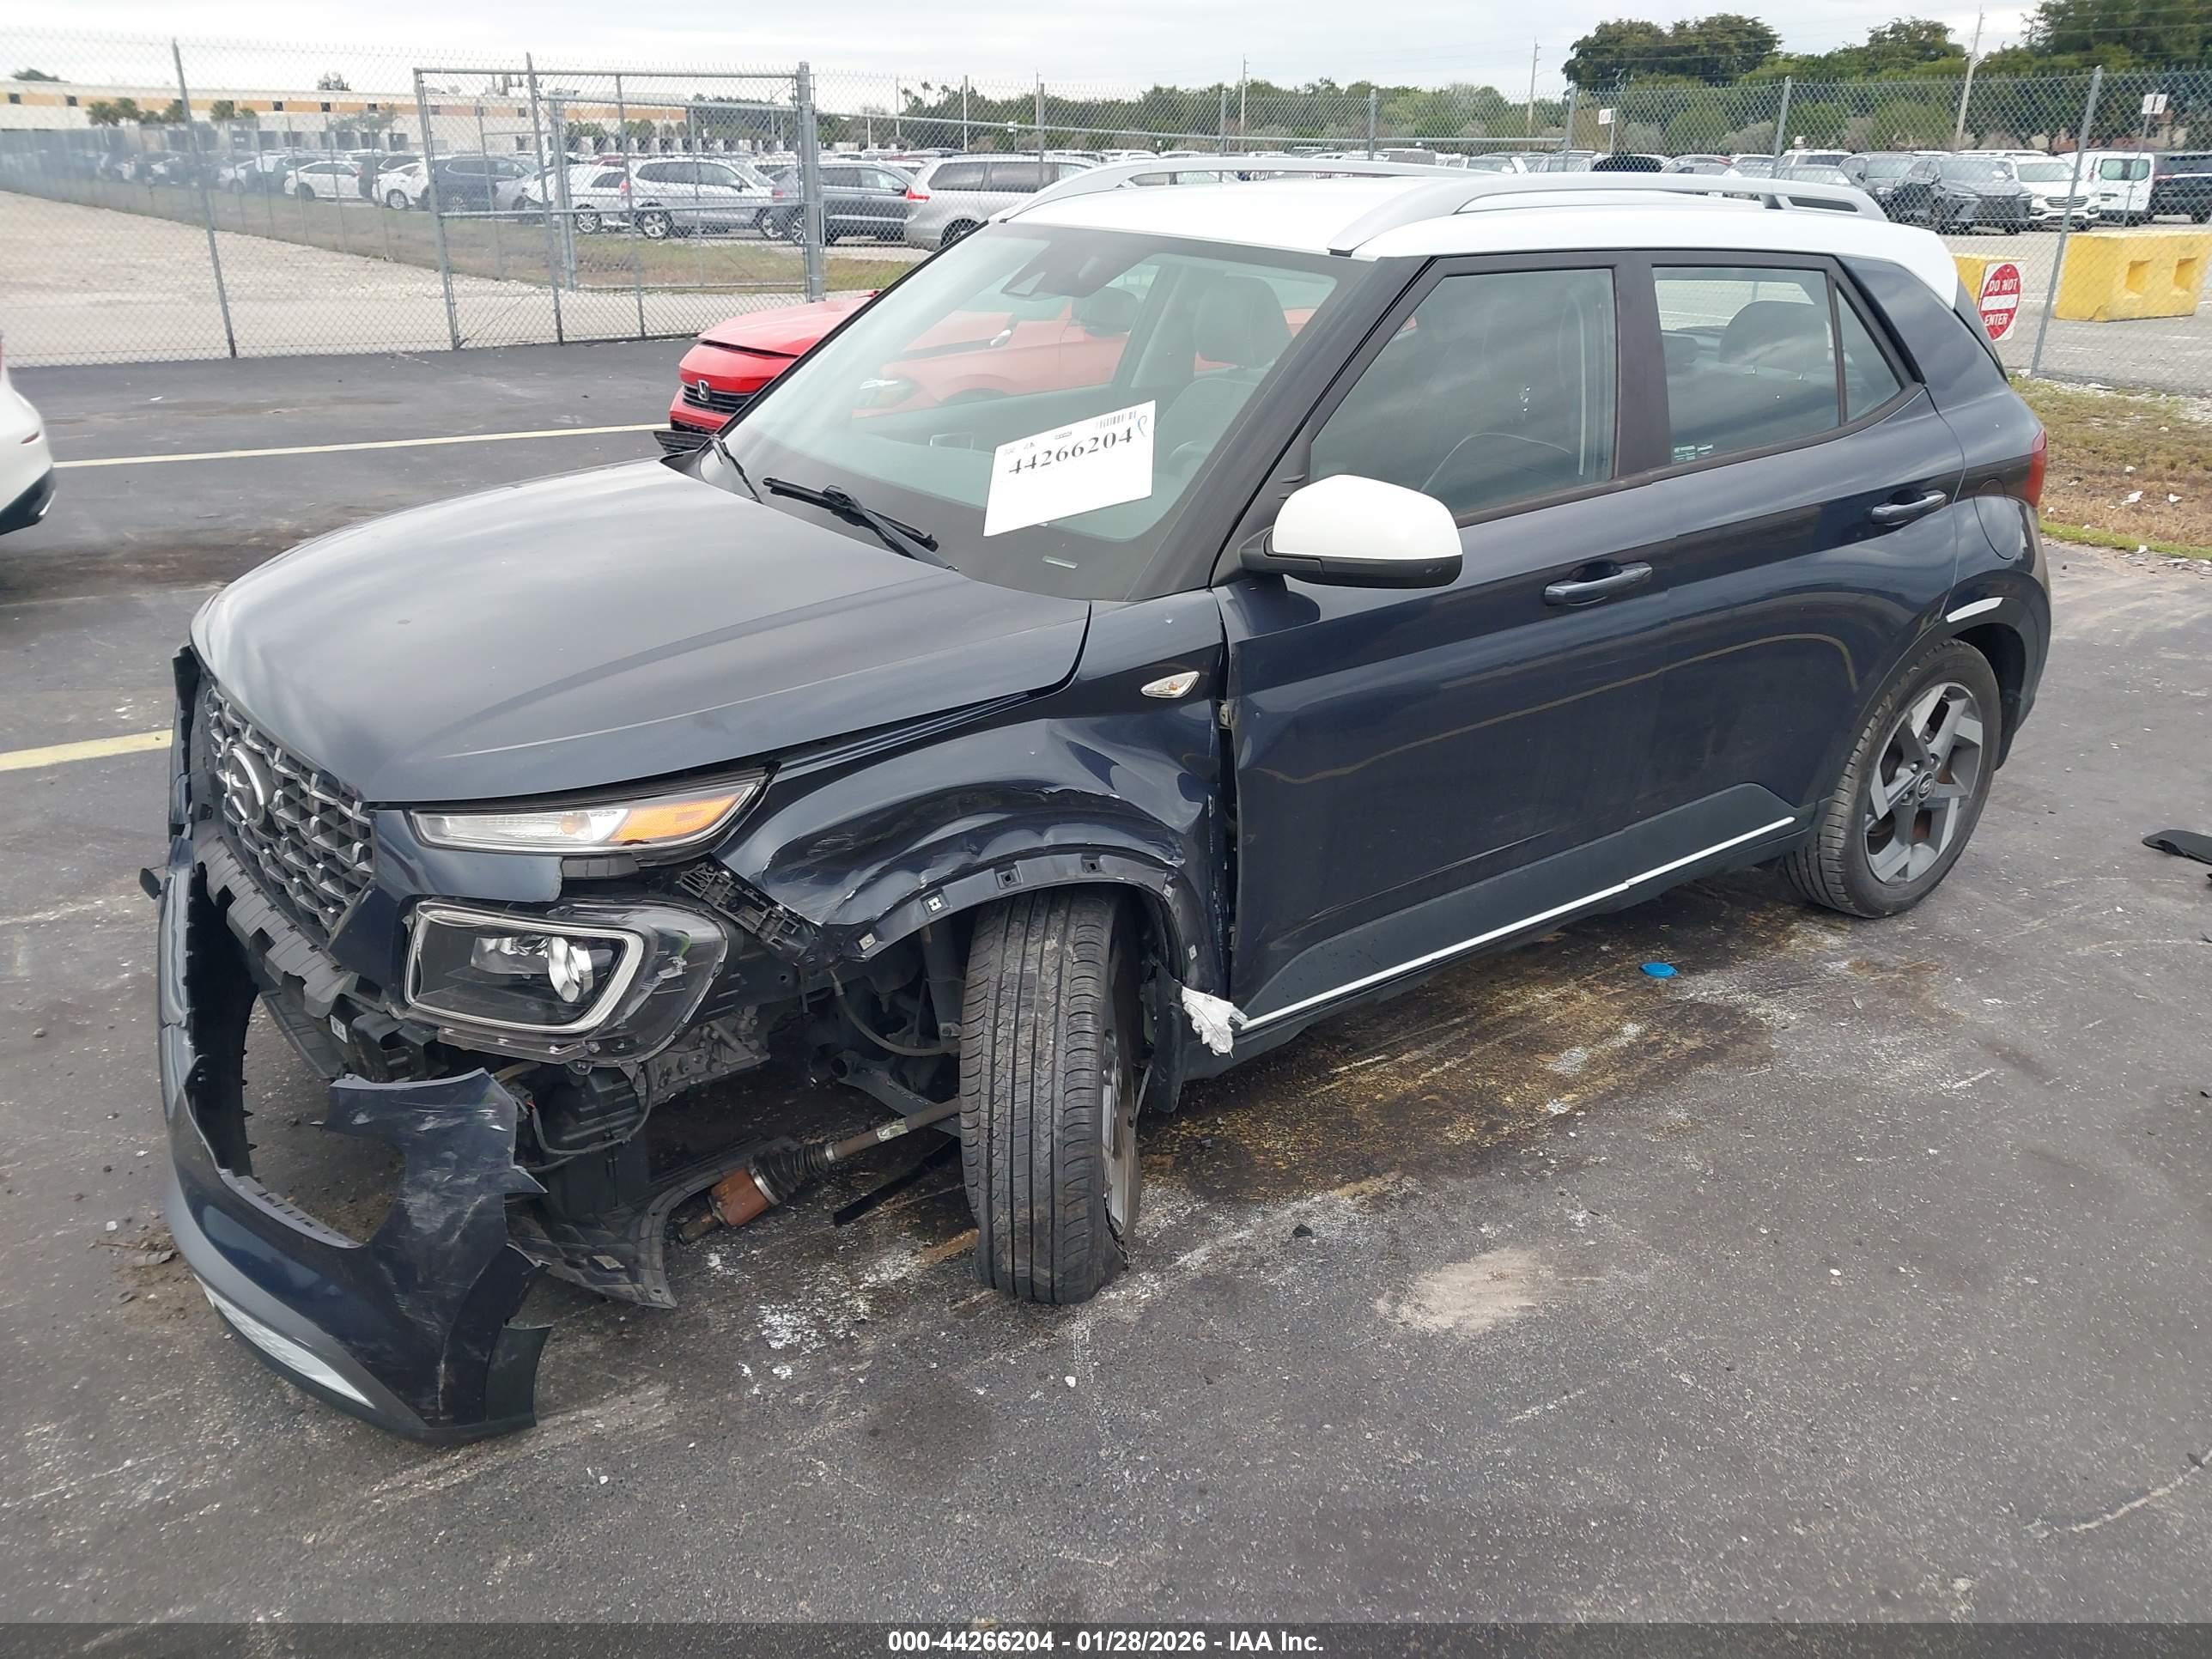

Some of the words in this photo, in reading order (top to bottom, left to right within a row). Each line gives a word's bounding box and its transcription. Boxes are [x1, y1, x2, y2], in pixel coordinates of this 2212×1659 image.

[1989, 280, 2001, 292] DO
[2002, 278, 2018, 291] NOT
[1984, 313, 2008, 326] ENTER
[1008, 426, 1133, 475] 44266204
